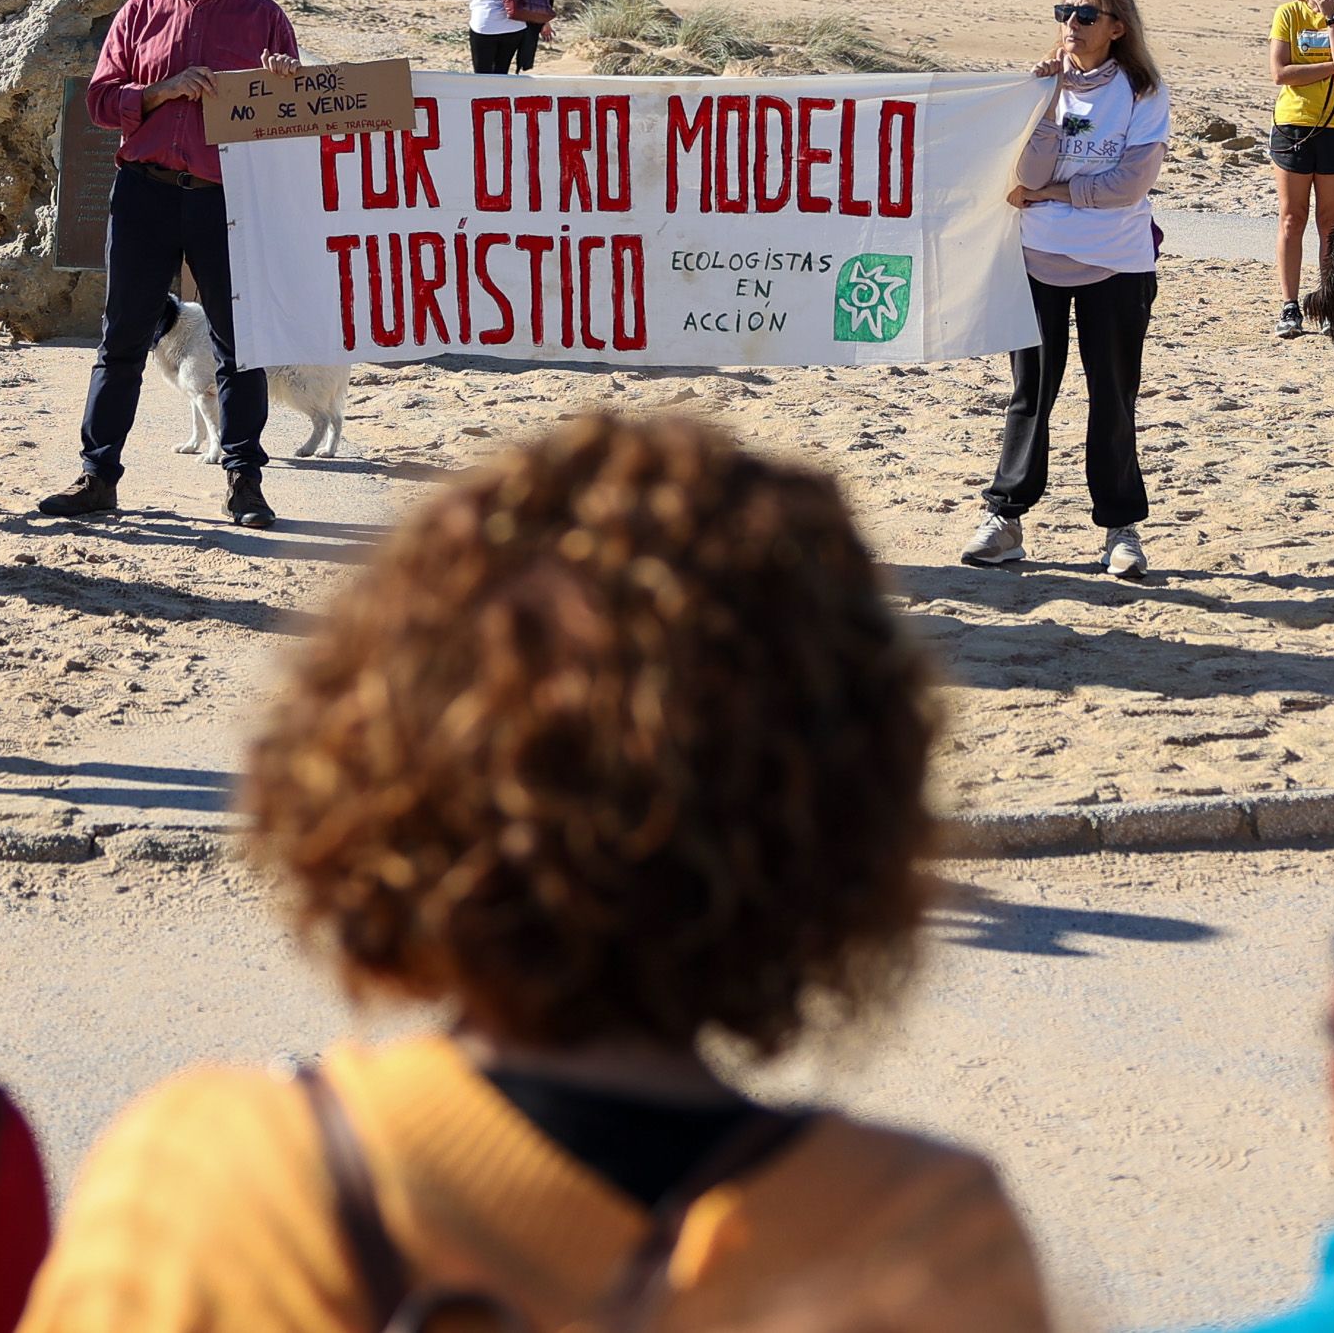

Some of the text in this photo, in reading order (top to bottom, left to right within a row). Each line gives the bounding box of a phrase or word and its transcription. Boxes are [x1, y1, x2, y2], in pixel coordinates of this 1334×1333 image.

[248, 73, 338, 99] EL FARO
[230, 93, 368, 122] NO SE VENDE
[252, 123, 319, 140] #LABATALLA
[325, 120, 338, 131] DE
[320, 94, 917, 218] POR OTRO MODELO
[671, 247, 833, 273] ECOLOGISTAS
[325, 217, 649, 352] TURÍSTICO
[736, 279, 772, 298] EN
[683, 301, 787, 333] ACCIÓN
